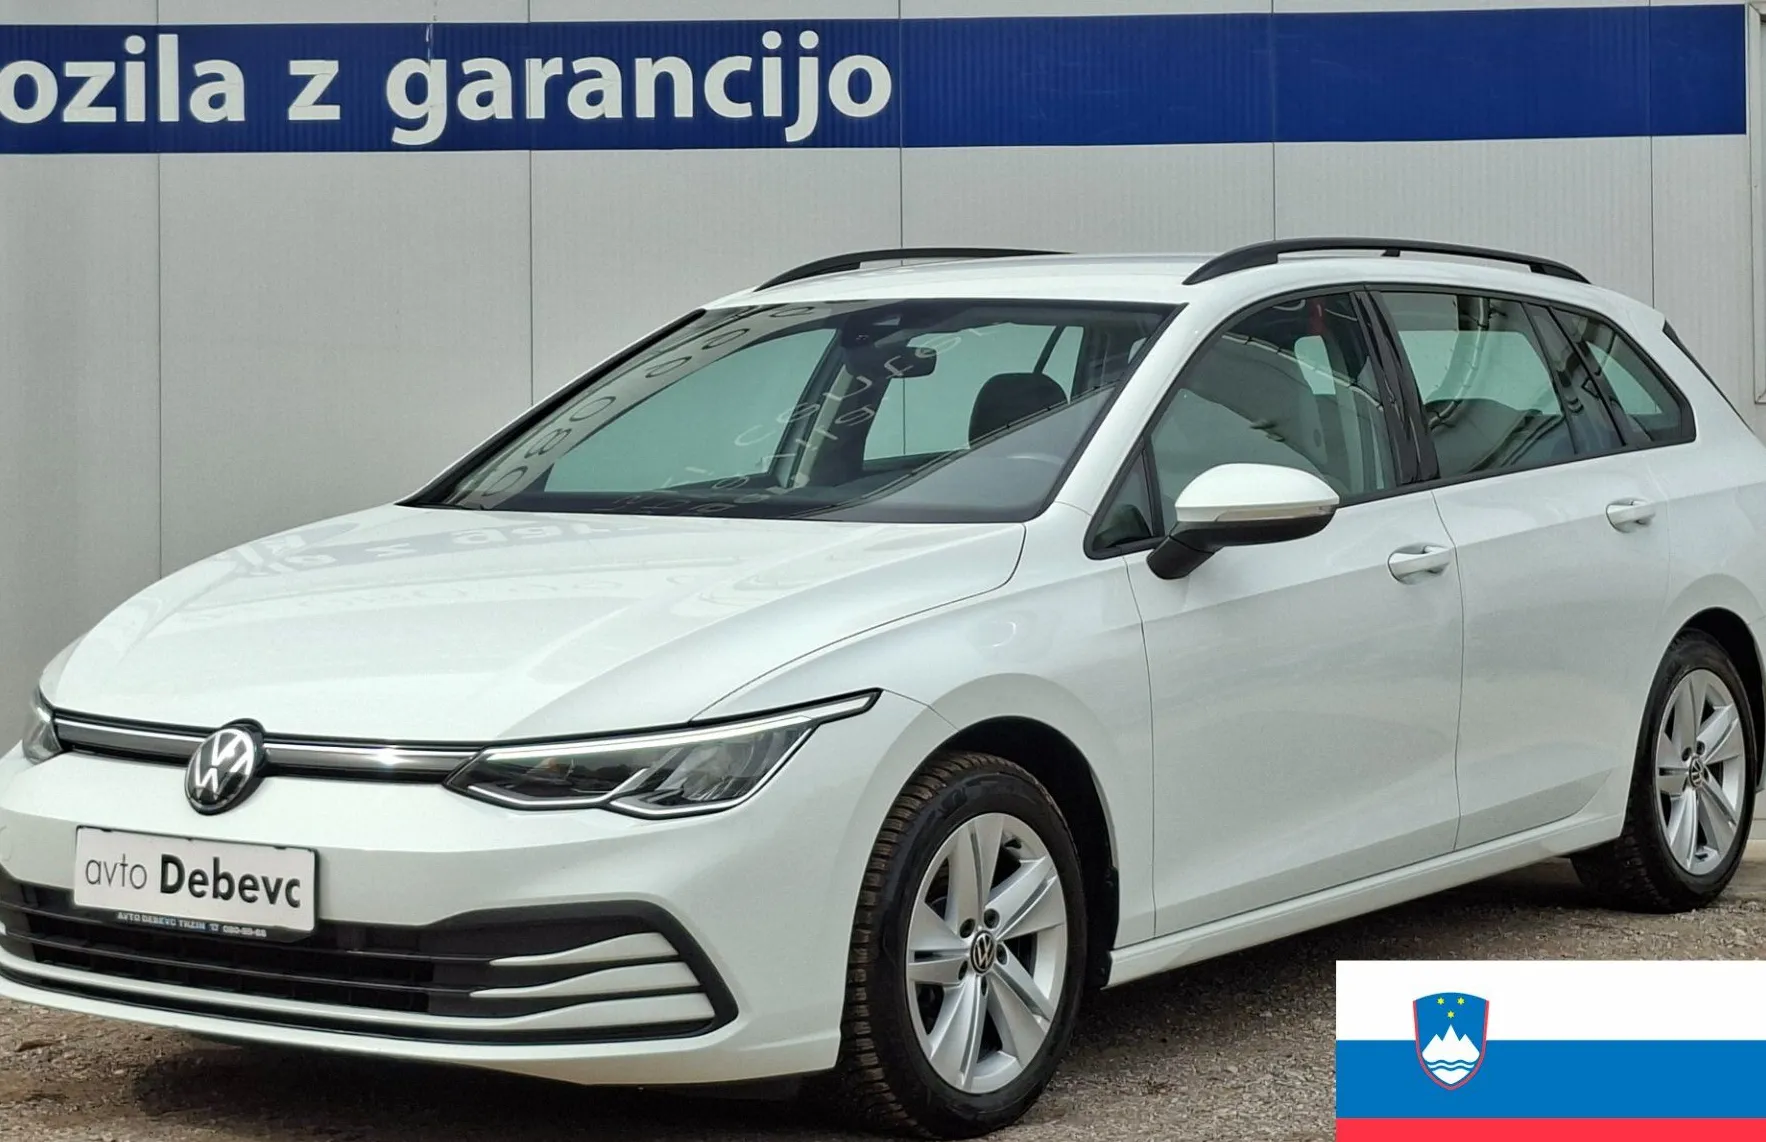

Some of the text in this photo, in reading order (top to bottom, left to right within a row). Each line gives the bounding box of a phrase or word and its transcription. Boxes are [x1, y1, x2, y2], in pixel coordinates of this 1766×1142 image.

[287, 59, 342, 121] z
[386, 30, 893, 145] garancijo
[85, 853, 301, 909] avto Debevc
[117, 911, 141, 922] AVTO
